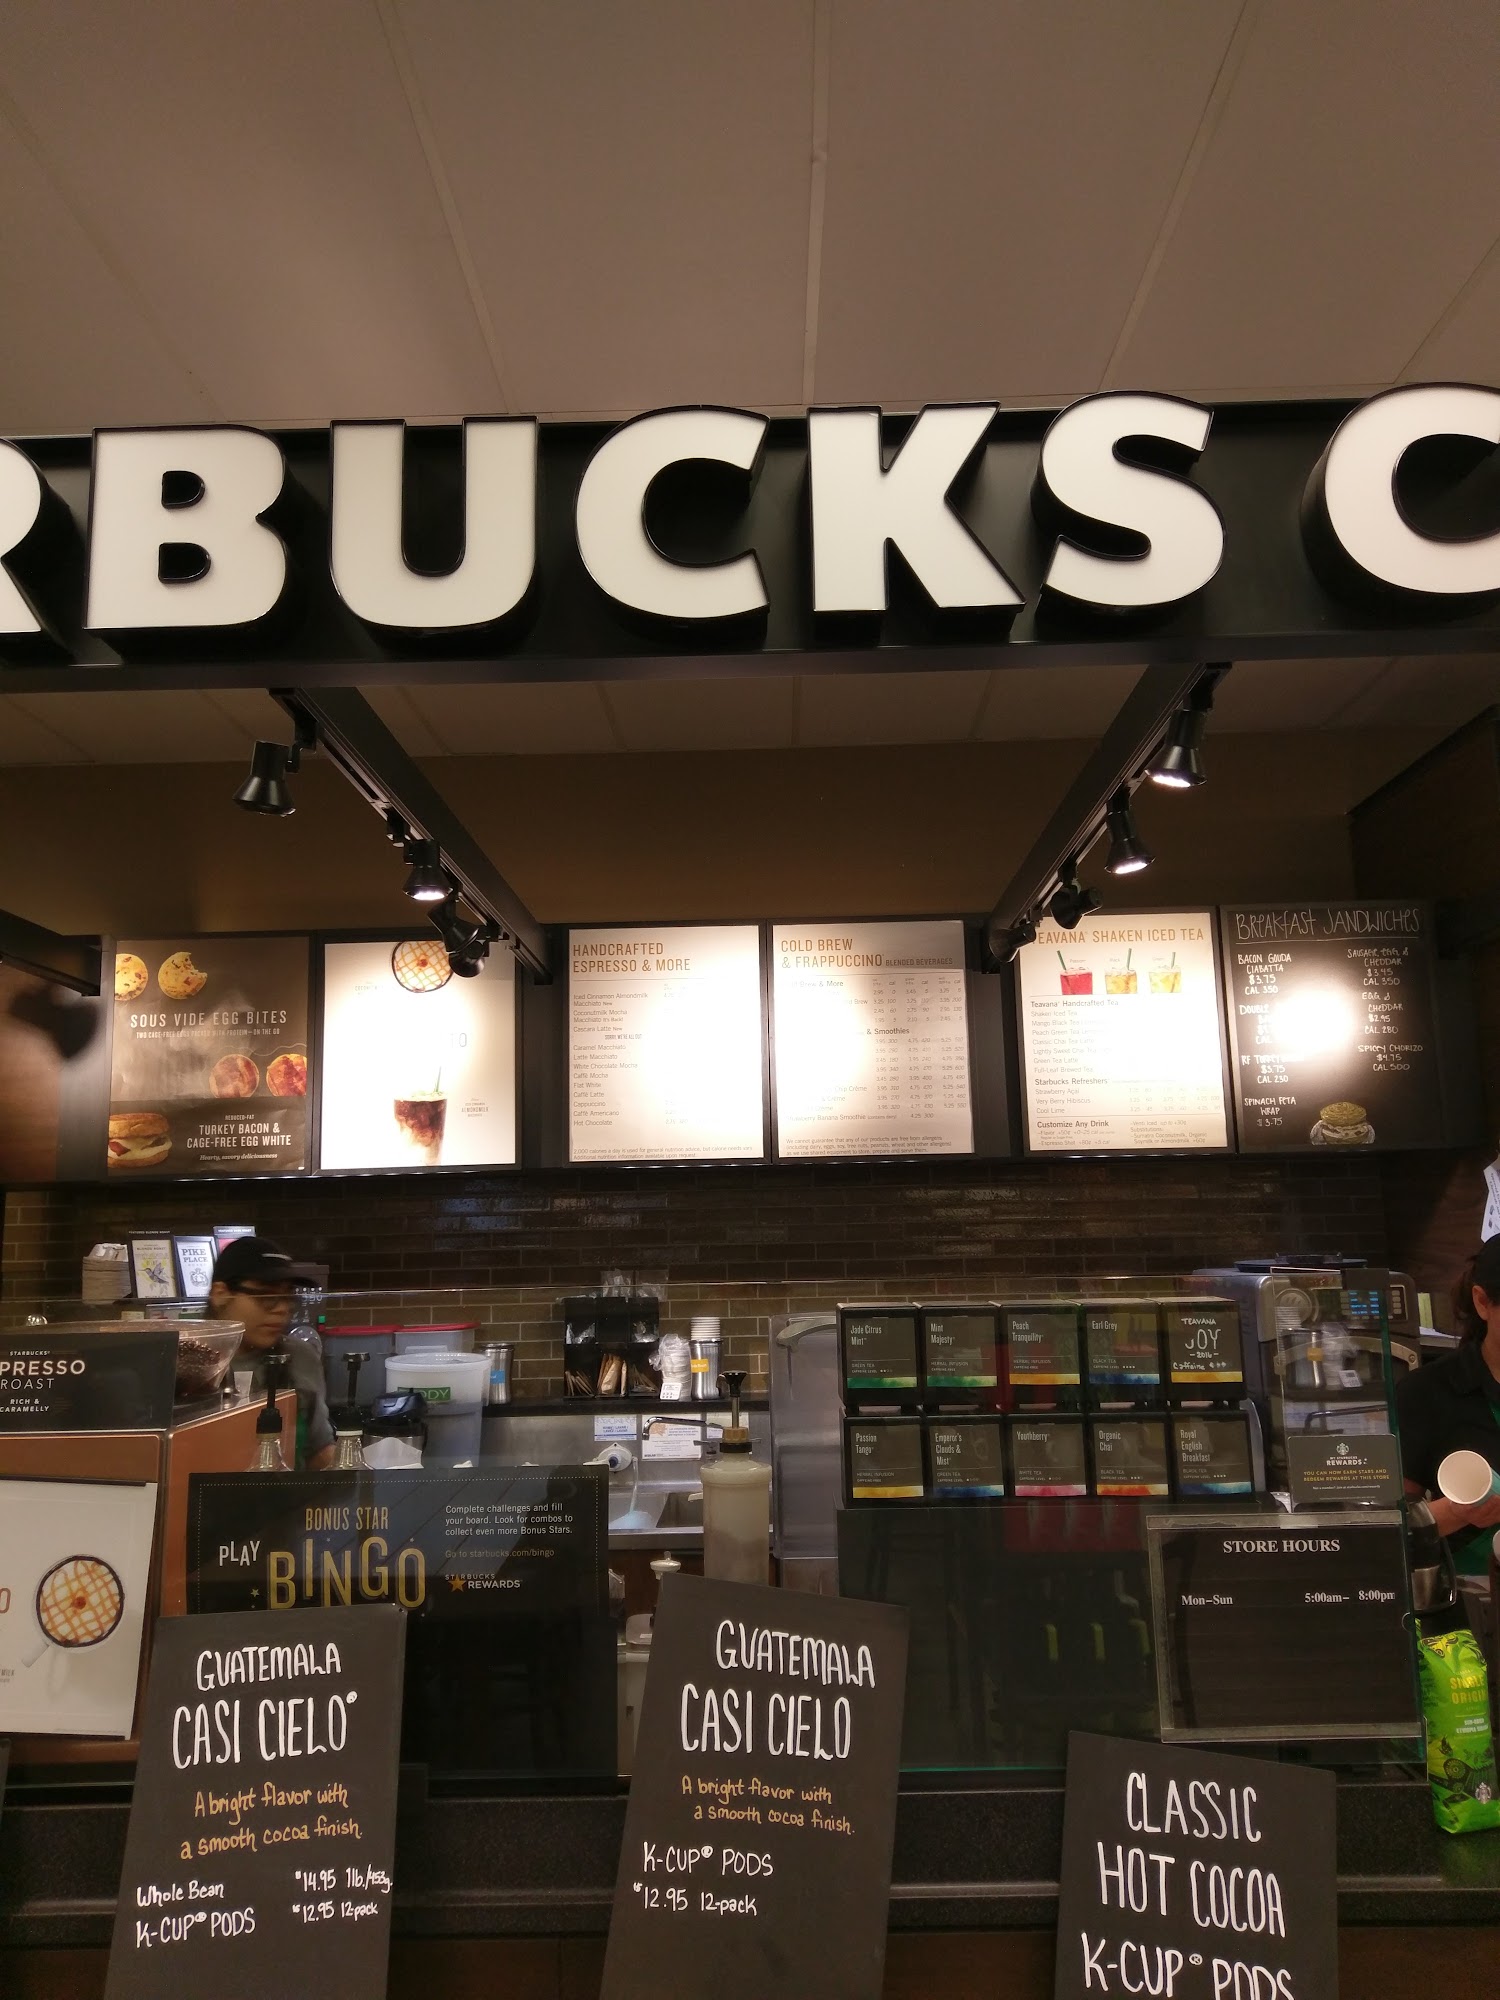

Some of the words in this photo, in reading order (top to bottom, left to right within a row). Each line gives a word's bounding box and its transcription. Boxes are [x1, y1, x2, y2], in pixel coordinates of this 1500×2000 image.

[0, 390, 1226, 634] BUCKS
[1093, 930, 1142, 942] SHAKEN
[1148, 929, 1175, 941] ICED
[1180, 928, 1204, 940] TEA
[573, 942, 663, 956] HANDCRAFTED
[781, 940, 812, 952] COLD
[818, 938, 853, 951] BREW
[782, 956, 791, 968] &
[1238, 954, 1263, 964] BACON
[1268, 954, 1292, 963] GOUDA
[573, 960, 637, 973] ESPRESSO
[642, 960, 651, 972] &
[656, 959, 690, 971] MORE
[1246, 965, 1284, 974] CIABATTA
[1249, 974, 1276, 985] $3.75
[1244, 987, 1261, 995] CAL
[1263, 985, 1279, 994] 350
[131, 1013, 166, 1028] SOUS
[174, 1012, 205, 1026] VIDE
[214, 1012, 239, 1025] EGG
[247, 1010, 287, 1024] BITES
[1368, 1014, 1390, 1023] $2.95
[1365, 1026, 1380, 1034] CAL
[1382, 1026, 1398, 1034] 280
[1257, 1075, 1272, 1084] CAL
[1274, 1075, 1289, 1083] 230
[199, 1124, 235, 1135] TURKEY
[239, 1123, 269, 1134] BACON
[273, 1122, 280, 1133] &
[187, 1137, 237, 1148] CAGE-FREE
[241, 1136, 258, 1147] EGG
[262, 1135, 291, 1145] WHITE
[181, 1248, 206, 1256] PIKE
[851, 1325, 864, 1334] Jade
[865, 1325, 881, 1334] Citrus
[931, 1323, 943, 1332] Mint
[1013, 1321, 1029, 1330] Peach
[1092, 1321, 1103, 1329] Earl
[1105, 1321, 1117, 1331] Grey
[1185, 1329, 1221, 1350] JOY
[0, 1378, 54, 1389] ROAST
[856, 1433, 877, 1442] Passion
[935, 1433, 962, 1444] Emperor's
[1099, 1430, 1121, 1440] Organic
[1181, 1430, 1197, 1439] Royal
[936, 1445, 954, 1454] Clouds
[956, 1445, 961, 1453] &
[1100, 1442, 1113, 1451] Chai
[1181, 1442, 1202, 1452] English
[1182, 1453, 1210, 1462] Breakfast
[446, 1505, 484, 1514] Complete
[487, 1504, 530, 1513] challenges
[533, 1504, 548, 1512] and
[551, 1503, 563, 1511] fill
[305, 1507, 350, 1531] BONUS
[356, 1507, 388, 1530] STAR
[445, 1517, 463, 1526] your
[466, 1516, 491, 1524] board.
[517, 1515, 528, 1523] for
[531, 1514, 562, 1522] combos
[565, 1514, 573, 1522] to
[446, 1528, 473, 1536] collect
[549, 1526, 573, 1534] Stars.
[1223, 1540, 1279, 1553] STORE
[1282, 1539, 1340, 1552] HOURS
[219, 1540, 260, 1567] PLAY
[445, 1550, 457, 1558] Go
[459, 1550, 467, 1558] to
[470, 1549, 555, 1558] starbucks.com/bingo
[267, 1536, 426, 1609] BINGO
[468, 1580, 520, 1589] REWARDS
[716, 1620, 876, 1688] GUATEMALA
[197, 1643, 341, 1692] GUATEMALA
[680, 1684, 753, 1753] CASI
[768, 1693, 850, 1760] CIELO
[173, 1700, 241, 1769] CASI
[682, 1775, 692, 1794] A
[698, 1778, 745, 1804] bright
[748, 1777, 795, 1800] flavor
[801, 1787, 832, 1804] with
[195, 1791, 206, 1817] A
[209, 1787, 256, 1826] bright
[261, 1782, 311, 1808] flavor
[317, 1783, 349, 1808] with
[1127, 1772, 1262, 1843] CLASSIC
[694, 1806, 702, 1820] a
[708, 1806, 762, 1824] smooth
[768, 1810, 805, 1826] cocoa
[811, 1809, 856, 1835] finish.
[180, 1841, 193, 1860] a
[198, 1828, 257, 1856] smooth
[263, 1824, 310, 1844] cocoa
[314, 1815, 363, 1840] finish.
[722, 1848, 774, 1876] PODS
[136, 1883, 183, 1908] Whole
[188, 1880, 225, 1900] Bean
[1097, 1841, 1175, 1916] HOT
[1190, 1861, 1286, 1938] COCOA
[700, 1892, 757, 1916] 12-pack
[211, 1907, 256, 1938] PODS
[341, 1902, 378, 1921] 12-pack
